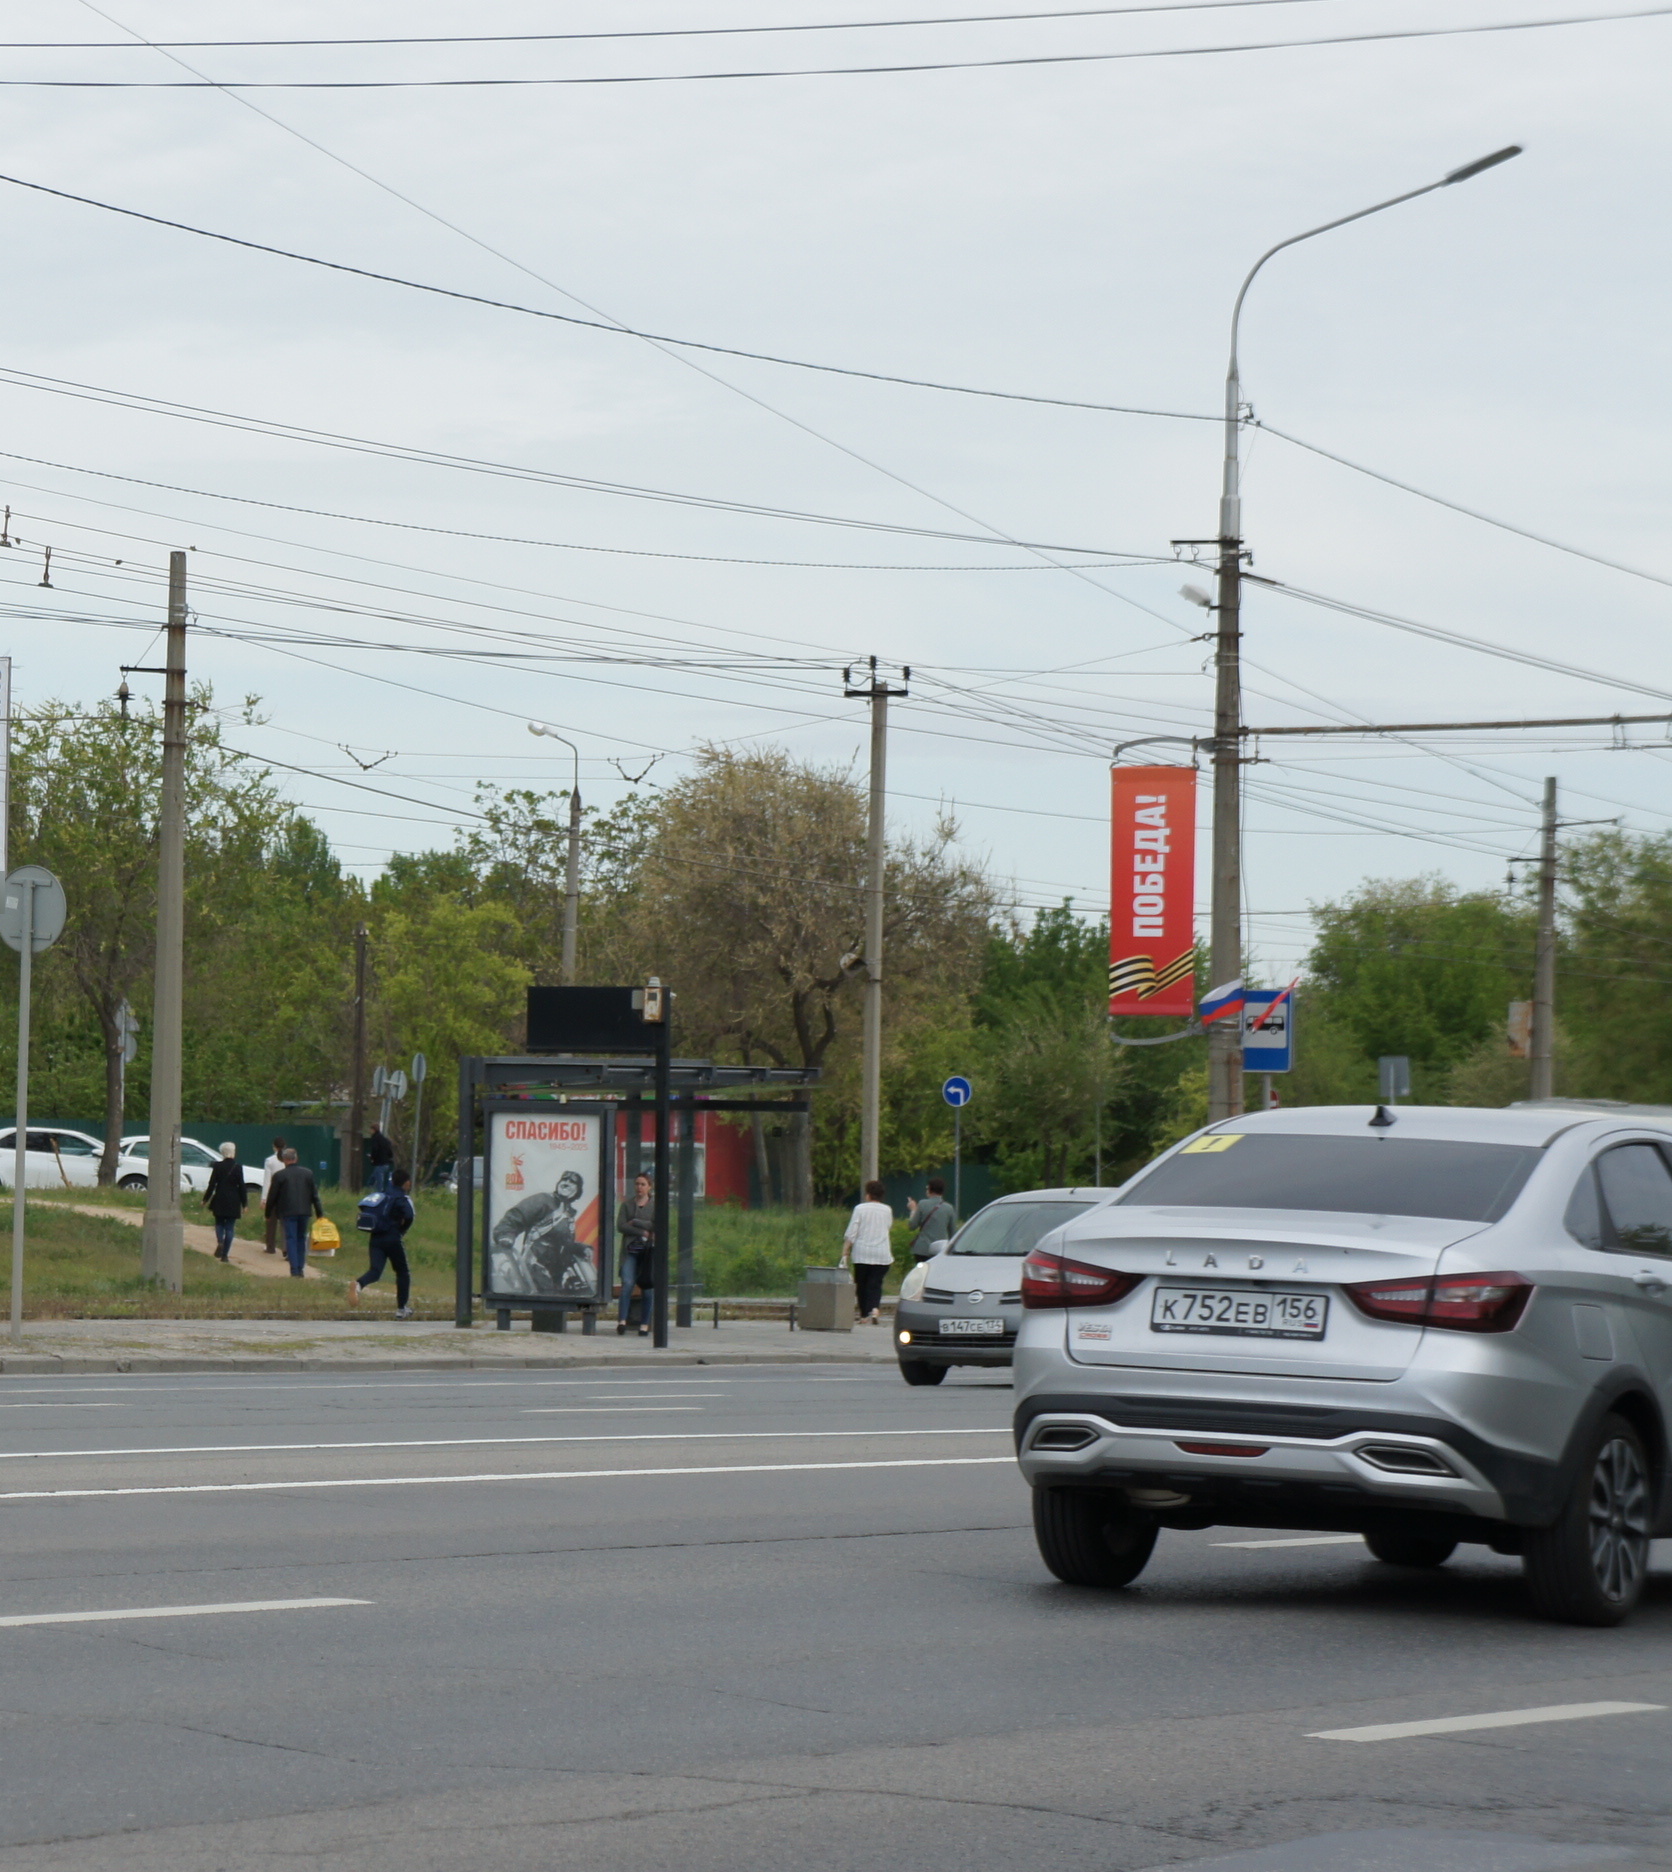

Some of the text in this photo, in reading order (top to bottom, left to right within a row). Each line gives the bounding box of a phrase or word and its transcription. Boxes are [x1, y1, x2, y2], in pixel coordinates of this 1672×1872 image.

[1132, 795, 1171, 937] ПОБЕДА!
[505, 1121, 587, 1141] СПАСИБО!
[1165, 1250, 1309, 1274] LADA
[1162, 1294, 1317, 1323] К752ЕВ 156
[1282, 1319, 1304, 1327] RUS
